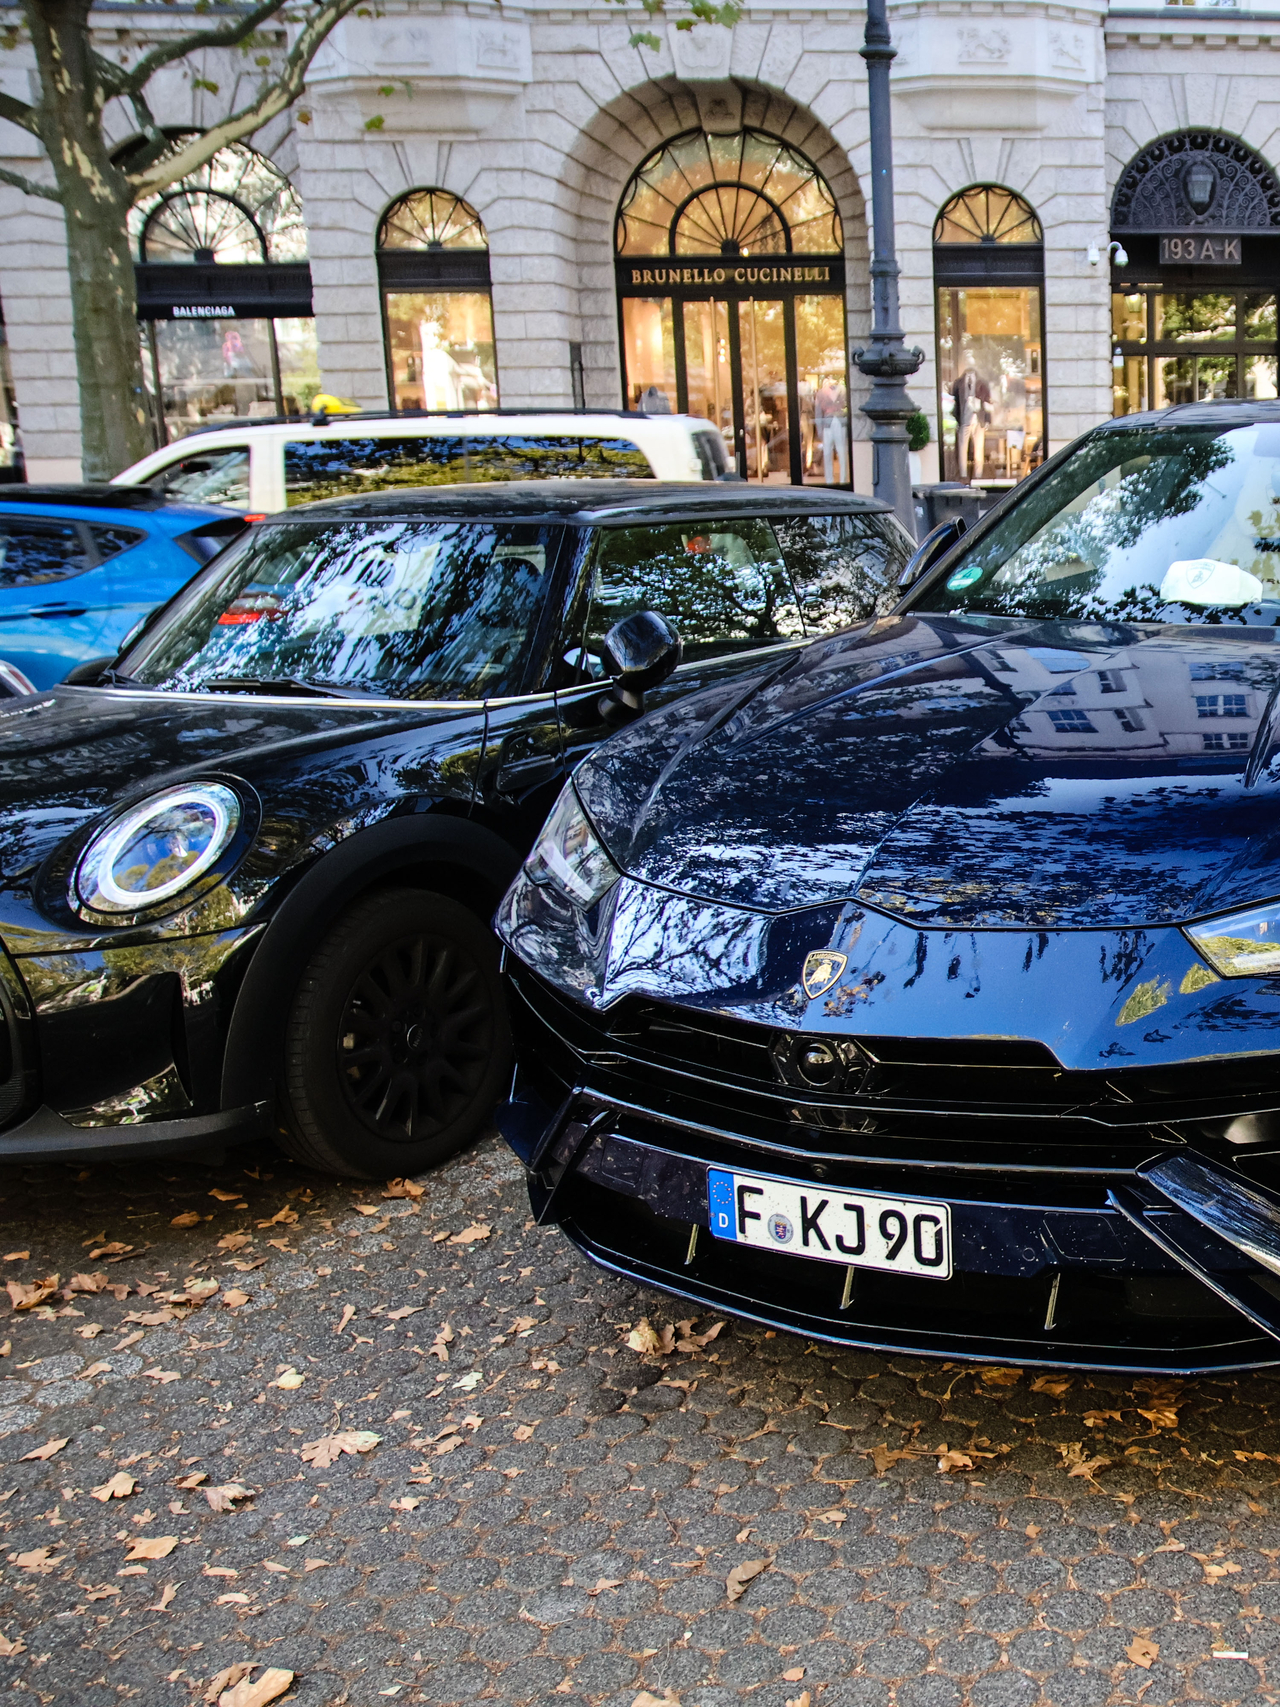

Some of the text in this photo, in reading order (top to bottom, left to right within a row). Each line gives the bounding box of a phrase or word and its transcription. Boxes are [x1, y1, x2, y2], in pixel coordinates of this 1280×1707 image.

[1163, 238, 1239, 260] 193 A-K
[631, 267, 830, 284] BRUNELLO CUCINELLI
[172, 306, 237, 318] BALENCIAGA
[718, 1212, 729, 1229] D
[736, 1184, 764, 1235] F
